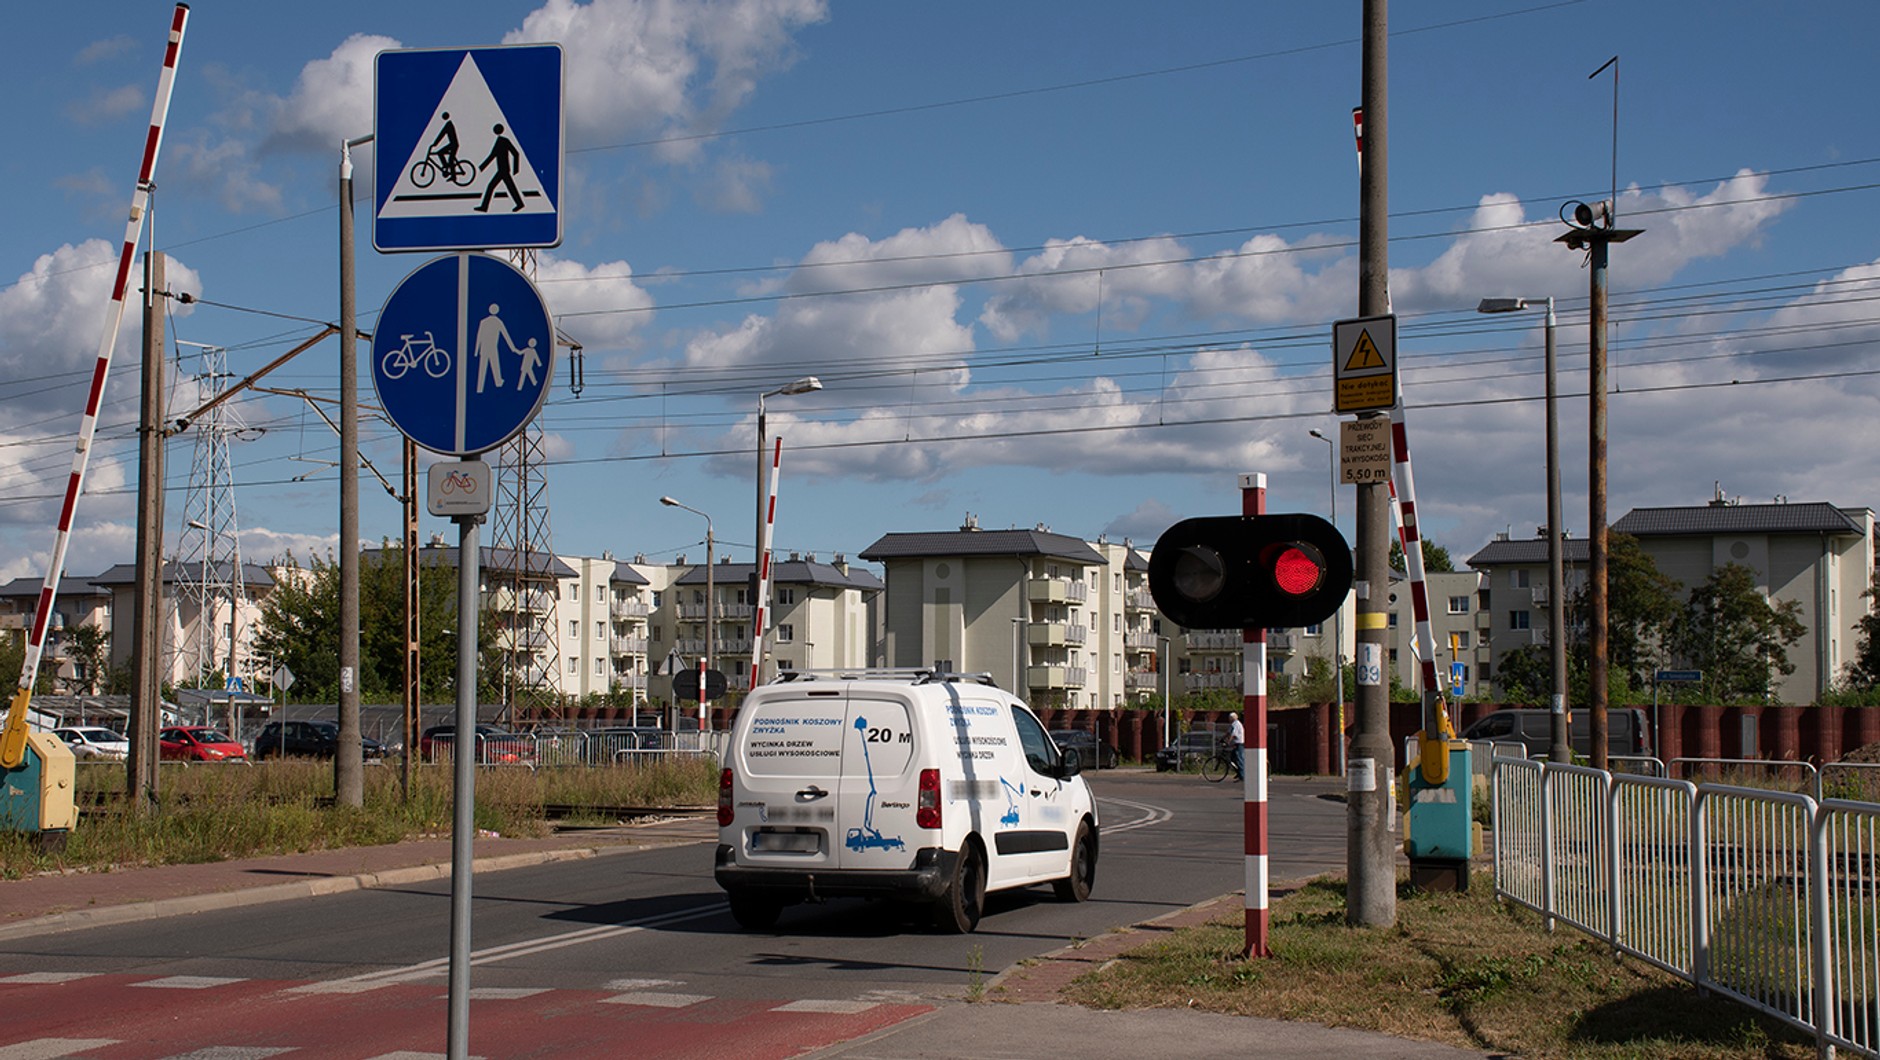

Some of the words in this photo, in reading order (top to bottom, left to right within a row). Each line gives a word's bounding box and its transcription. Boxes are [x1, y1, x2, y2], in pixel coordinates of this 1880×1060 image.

[1374, 468, 1386, 478] m
[1364, 645, 1371, 662] 1
[868, 728, 892, 743] 20
[899, 733, 911, 743] M
